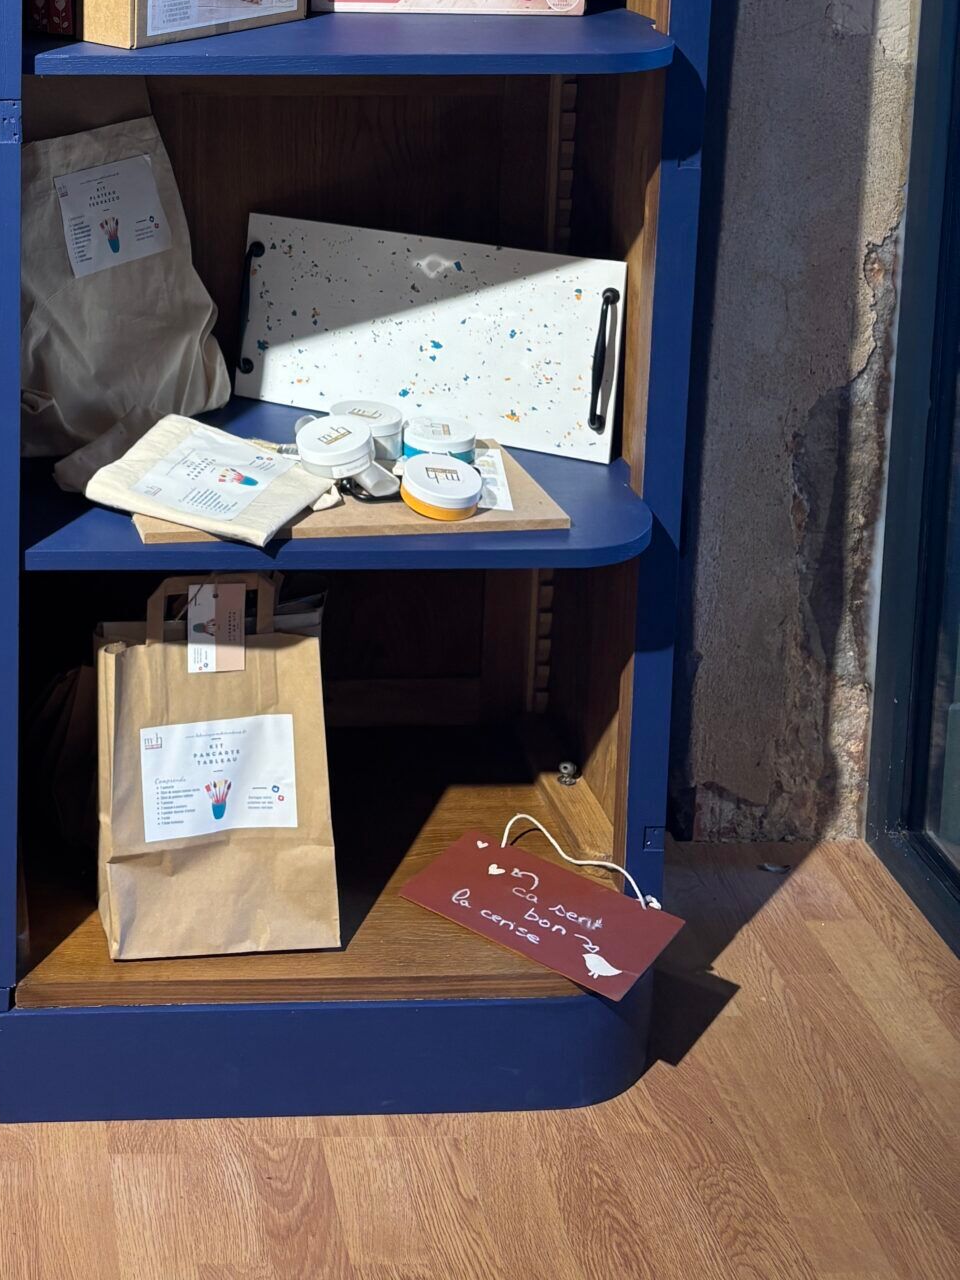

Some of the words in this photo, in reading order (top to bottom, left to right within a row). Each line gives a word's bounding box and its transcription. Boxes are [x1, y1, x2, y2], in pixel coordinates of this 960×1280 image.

[193, 749, 241, 758] PANCARTE
[197, 757, 238, 766] TABLEAU
[451, 888, 471, 908] la
[480, 909, 540, 945] cerise
[523, 908, 566, 936] bon
[548, 904, 604, 930] sent
